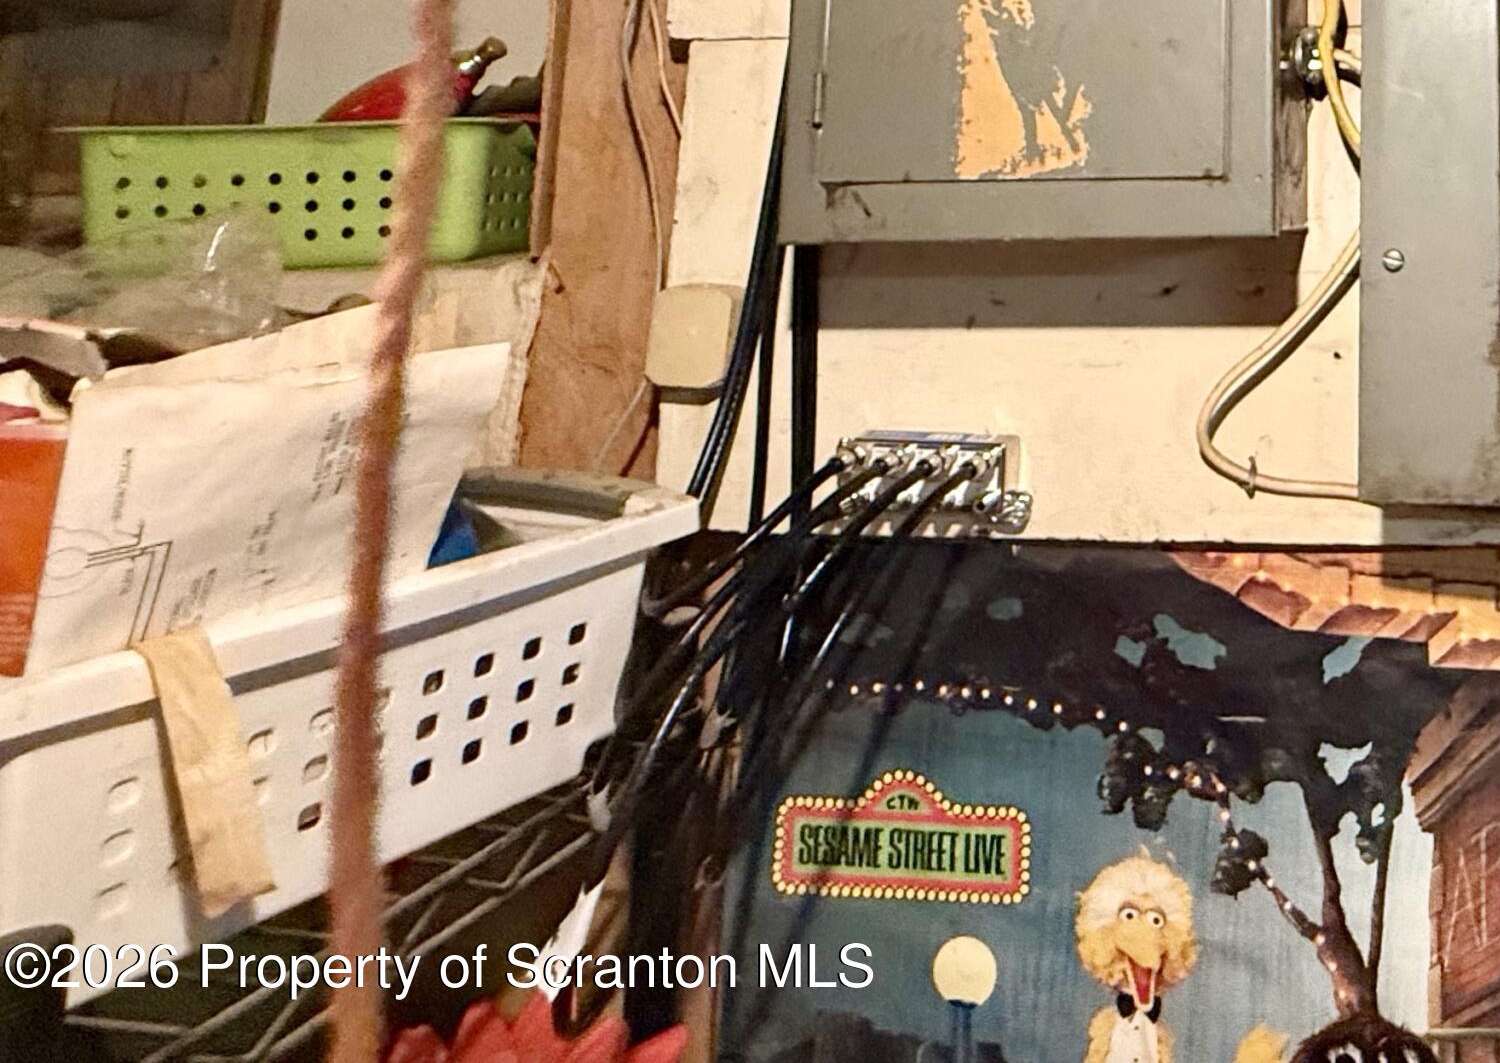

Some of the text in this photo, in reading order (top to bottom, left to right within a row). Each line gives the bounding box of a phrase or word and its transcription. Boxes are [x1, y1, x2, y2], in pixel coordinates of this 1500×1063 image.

[886, 794, 920, 811] CTW
[799, 824, 1006, 875] SESAME STREET LIVE
